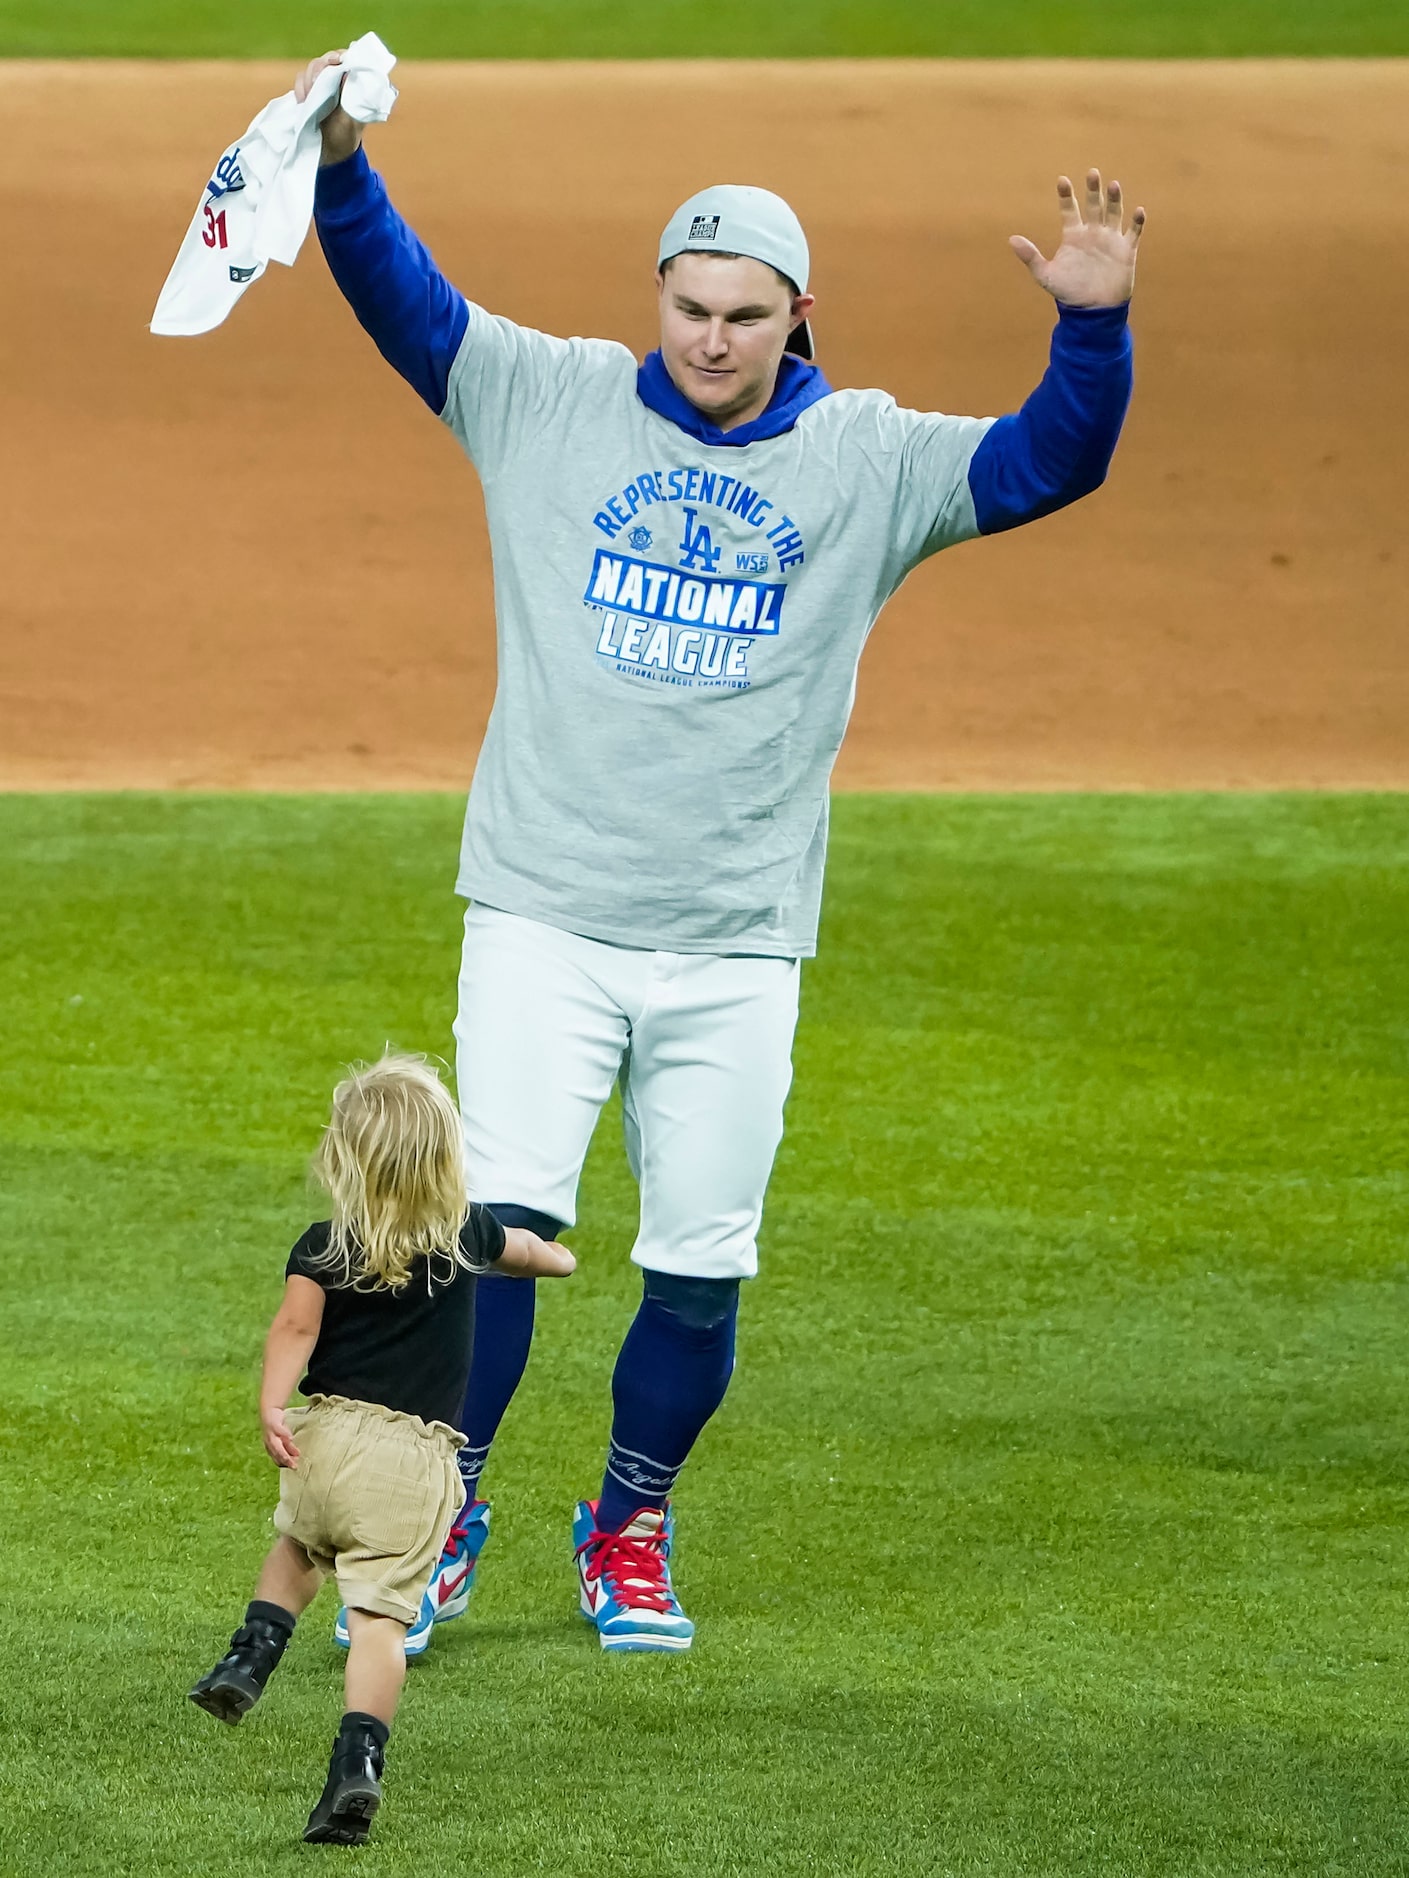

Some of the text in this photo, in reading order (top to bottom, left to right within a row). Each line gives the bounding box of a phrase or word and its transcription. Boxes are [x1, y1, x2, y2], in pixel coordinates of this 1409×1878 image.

[202, 205, 228, 249] 31
[593, 469, 805, 573] REPRESENTING THE
[678, 506, 721, 573] LA
[591, 556, 776, 631] NATIONAL
[595, 611, 754, 678] LEAGUE
[616, 664, 749, 689] NATIONAL LEAGUE CHAMPIONS
